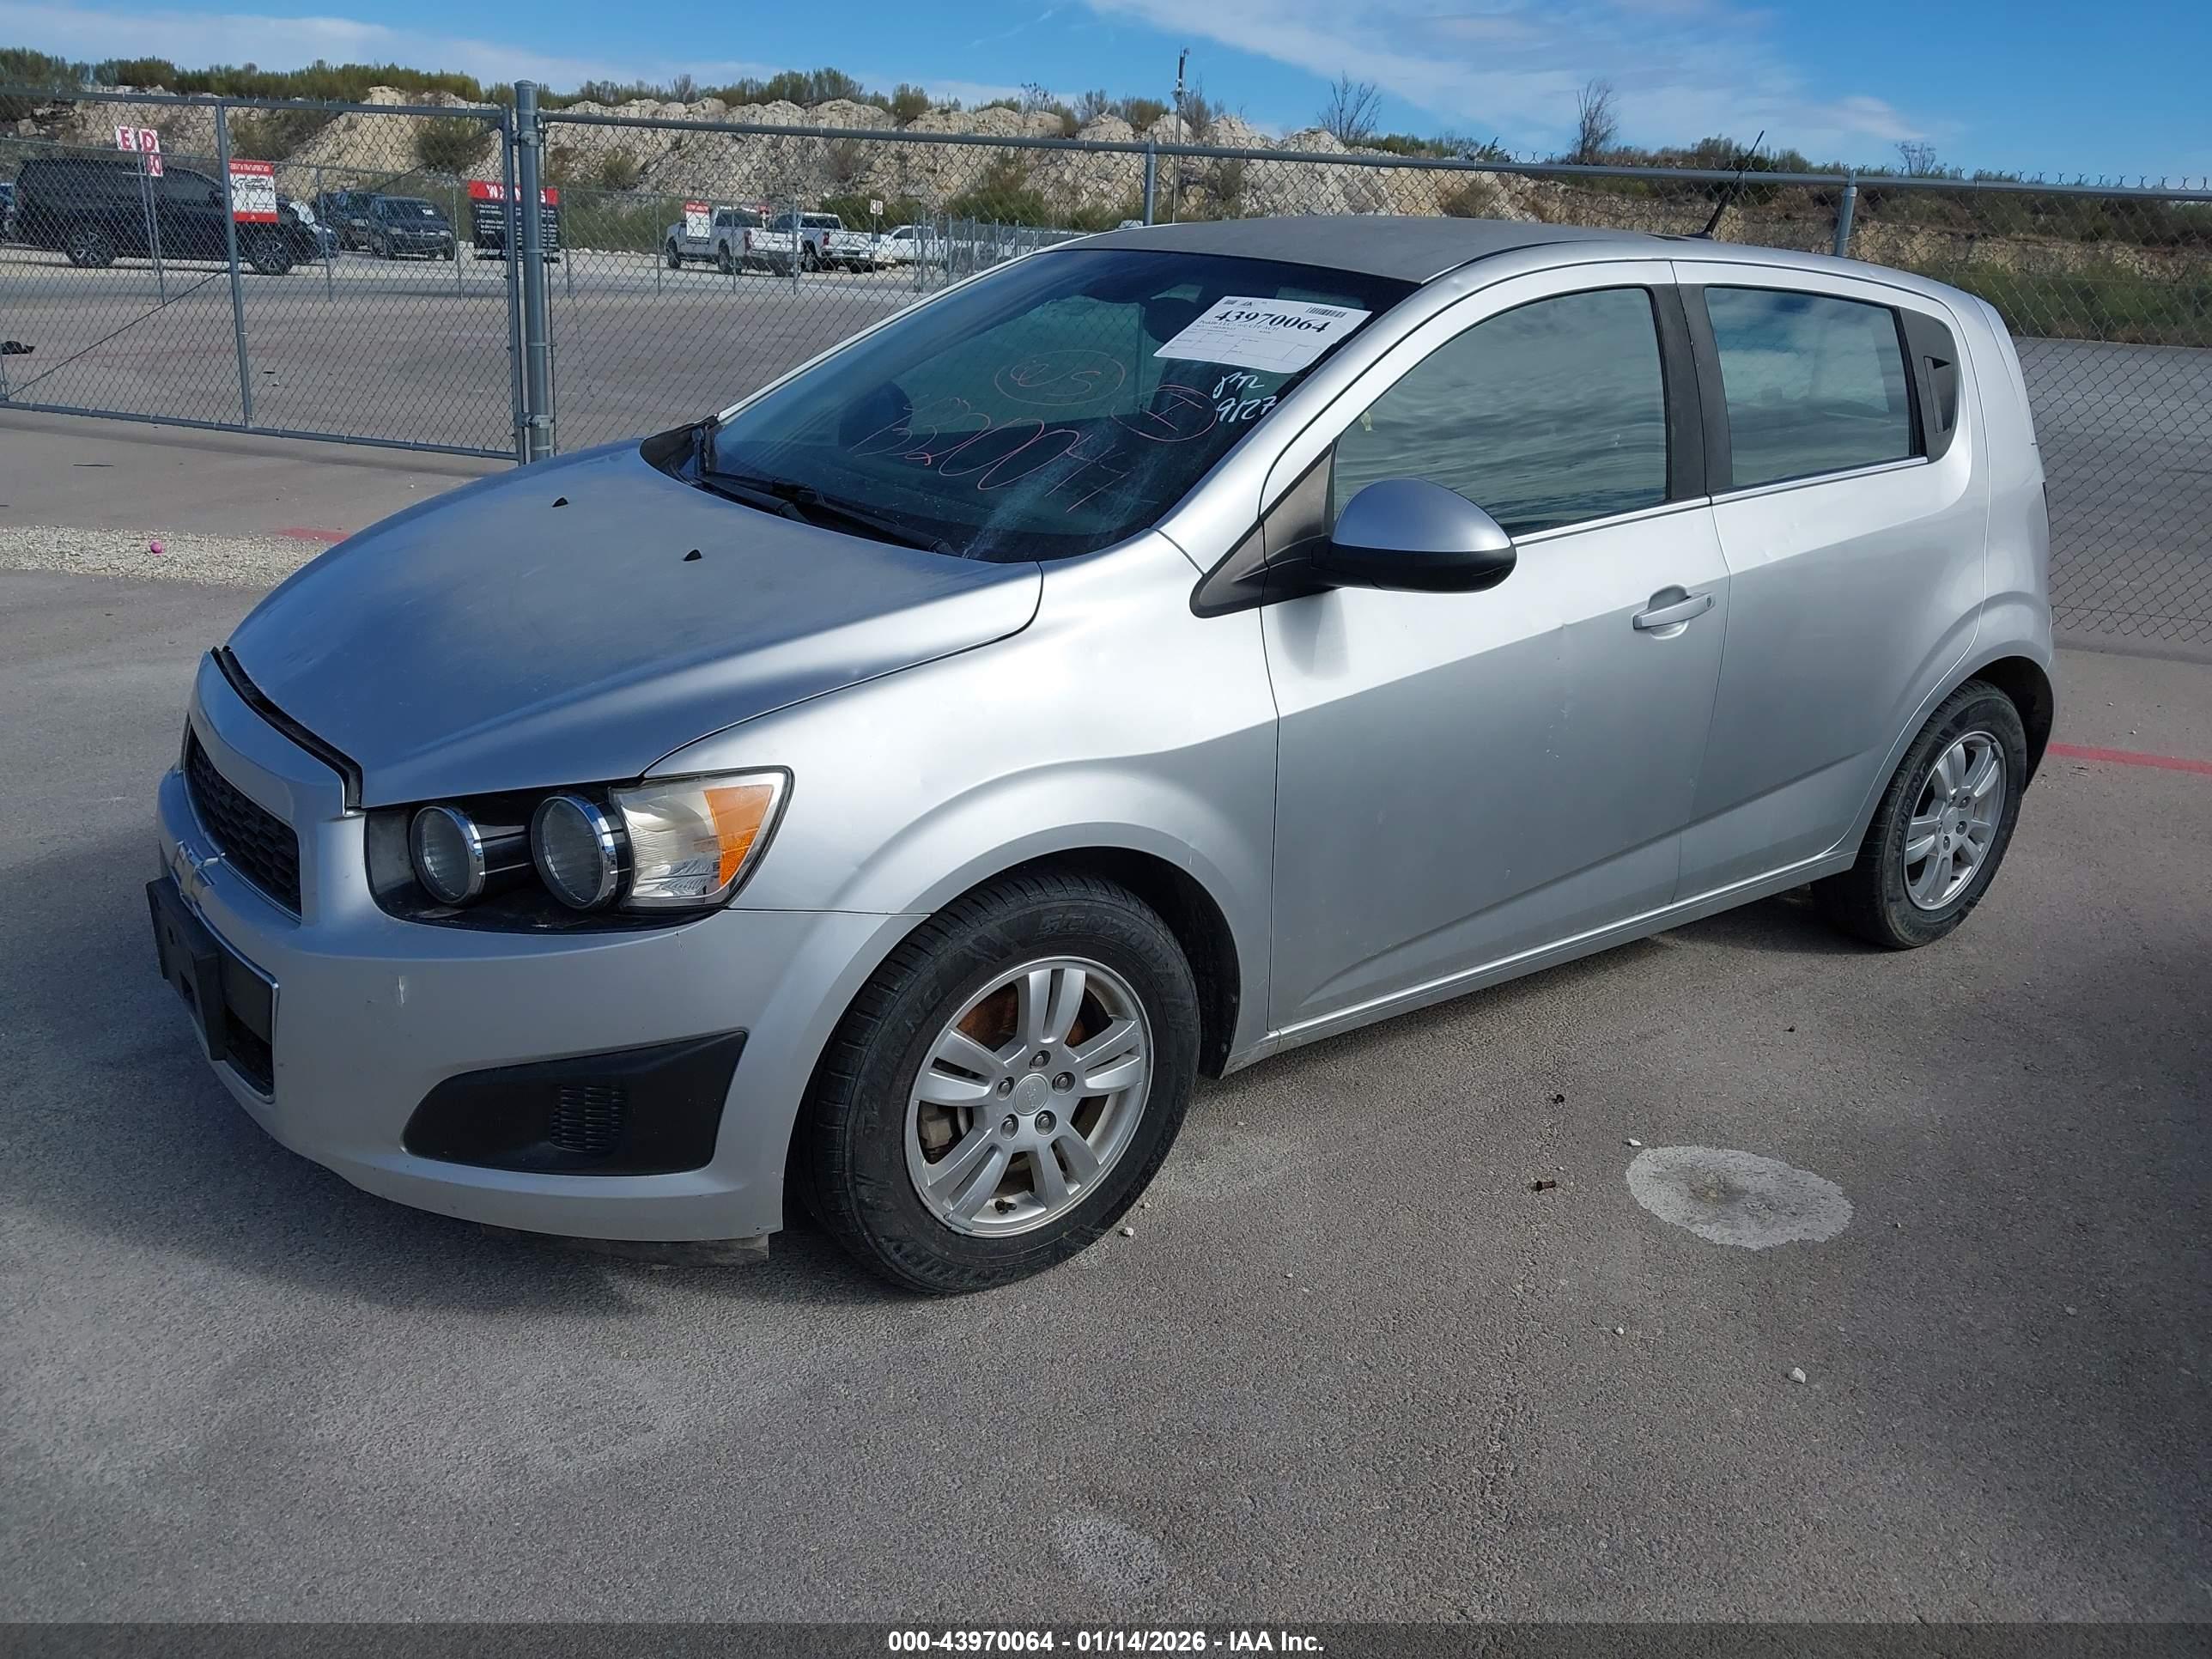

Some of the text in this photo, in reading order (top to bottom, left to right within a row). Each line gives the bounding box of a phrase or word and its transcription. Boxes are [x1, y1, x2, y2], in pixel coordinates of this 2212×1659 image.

[120, 129, 132, 149] E
[141, 131, 156, 152] D
[1214, 309, 1331, 333] 43970064
